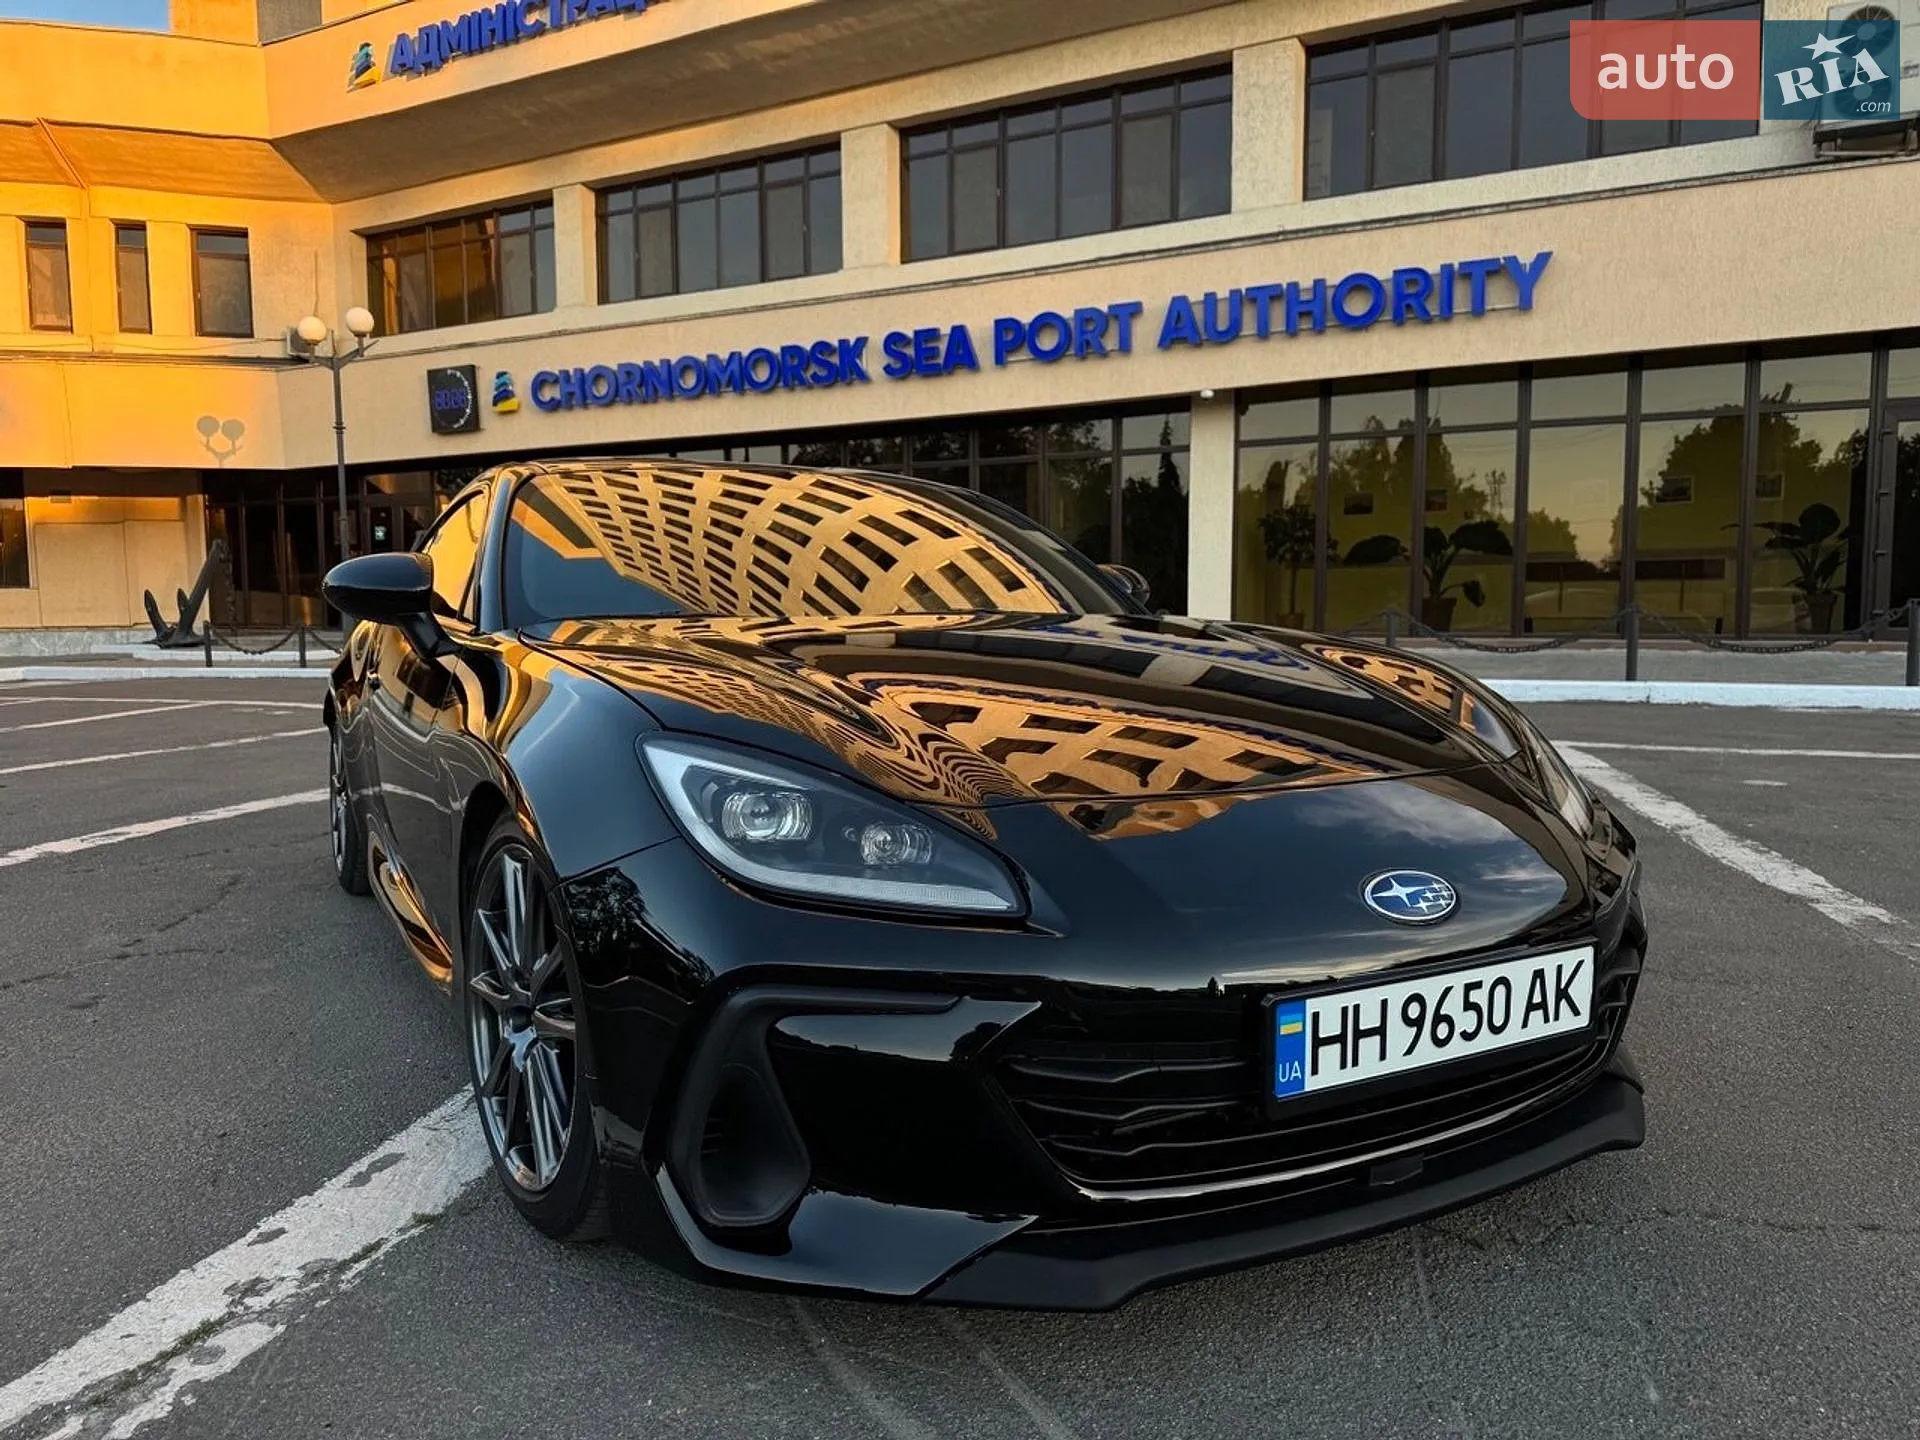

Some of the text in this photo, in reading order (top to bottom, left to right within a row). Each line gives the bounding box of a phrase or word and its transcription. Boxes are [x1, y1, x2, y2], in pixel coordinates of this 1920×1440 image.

[390, 0, 648, 74] АДМІНІСТР
[530, 251, 1554, 412] CHORNOMORSK SEA PORT AUTHORITY
[1310, 959, 1586, 1077] HH 9650 AK
[1278, 1060, 1303, 1083] UA
